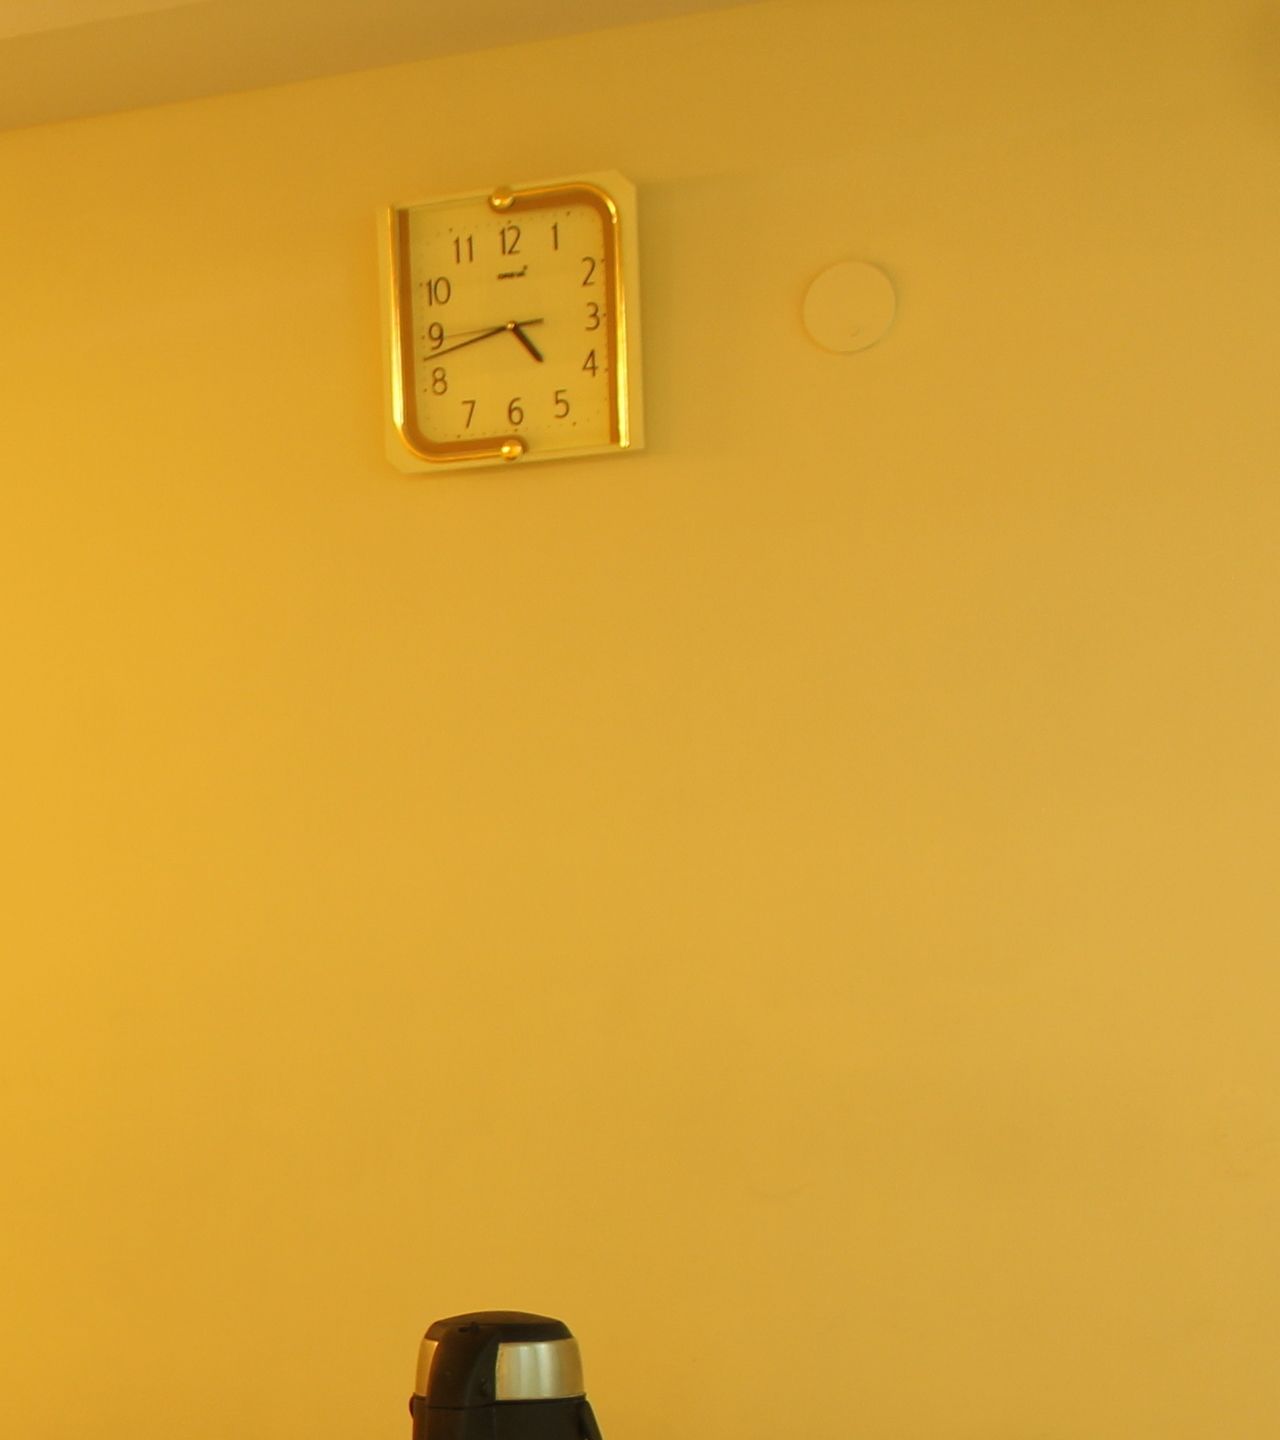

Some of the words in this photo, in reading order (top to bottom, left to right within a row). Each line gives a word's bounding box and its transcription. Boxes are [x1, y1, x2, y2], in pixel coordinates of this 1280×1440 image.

[454, 235, 474, 264] 11
[499, 225, 521, 255] 12
[551, 222, 559, 251] 1
[582, 257, 596, 287] 2
[426, 276, 451, 306] 10
[585, 302, 600, 331] 3
[428, 322, 444, 350] 9
[582, 350, 598, 377] 4
[432, 367, 447, 396] 8
[461, 400, 476, 429] 7
[507, 397, 524, 426] 6
[554, 389, 570, 419] 5
